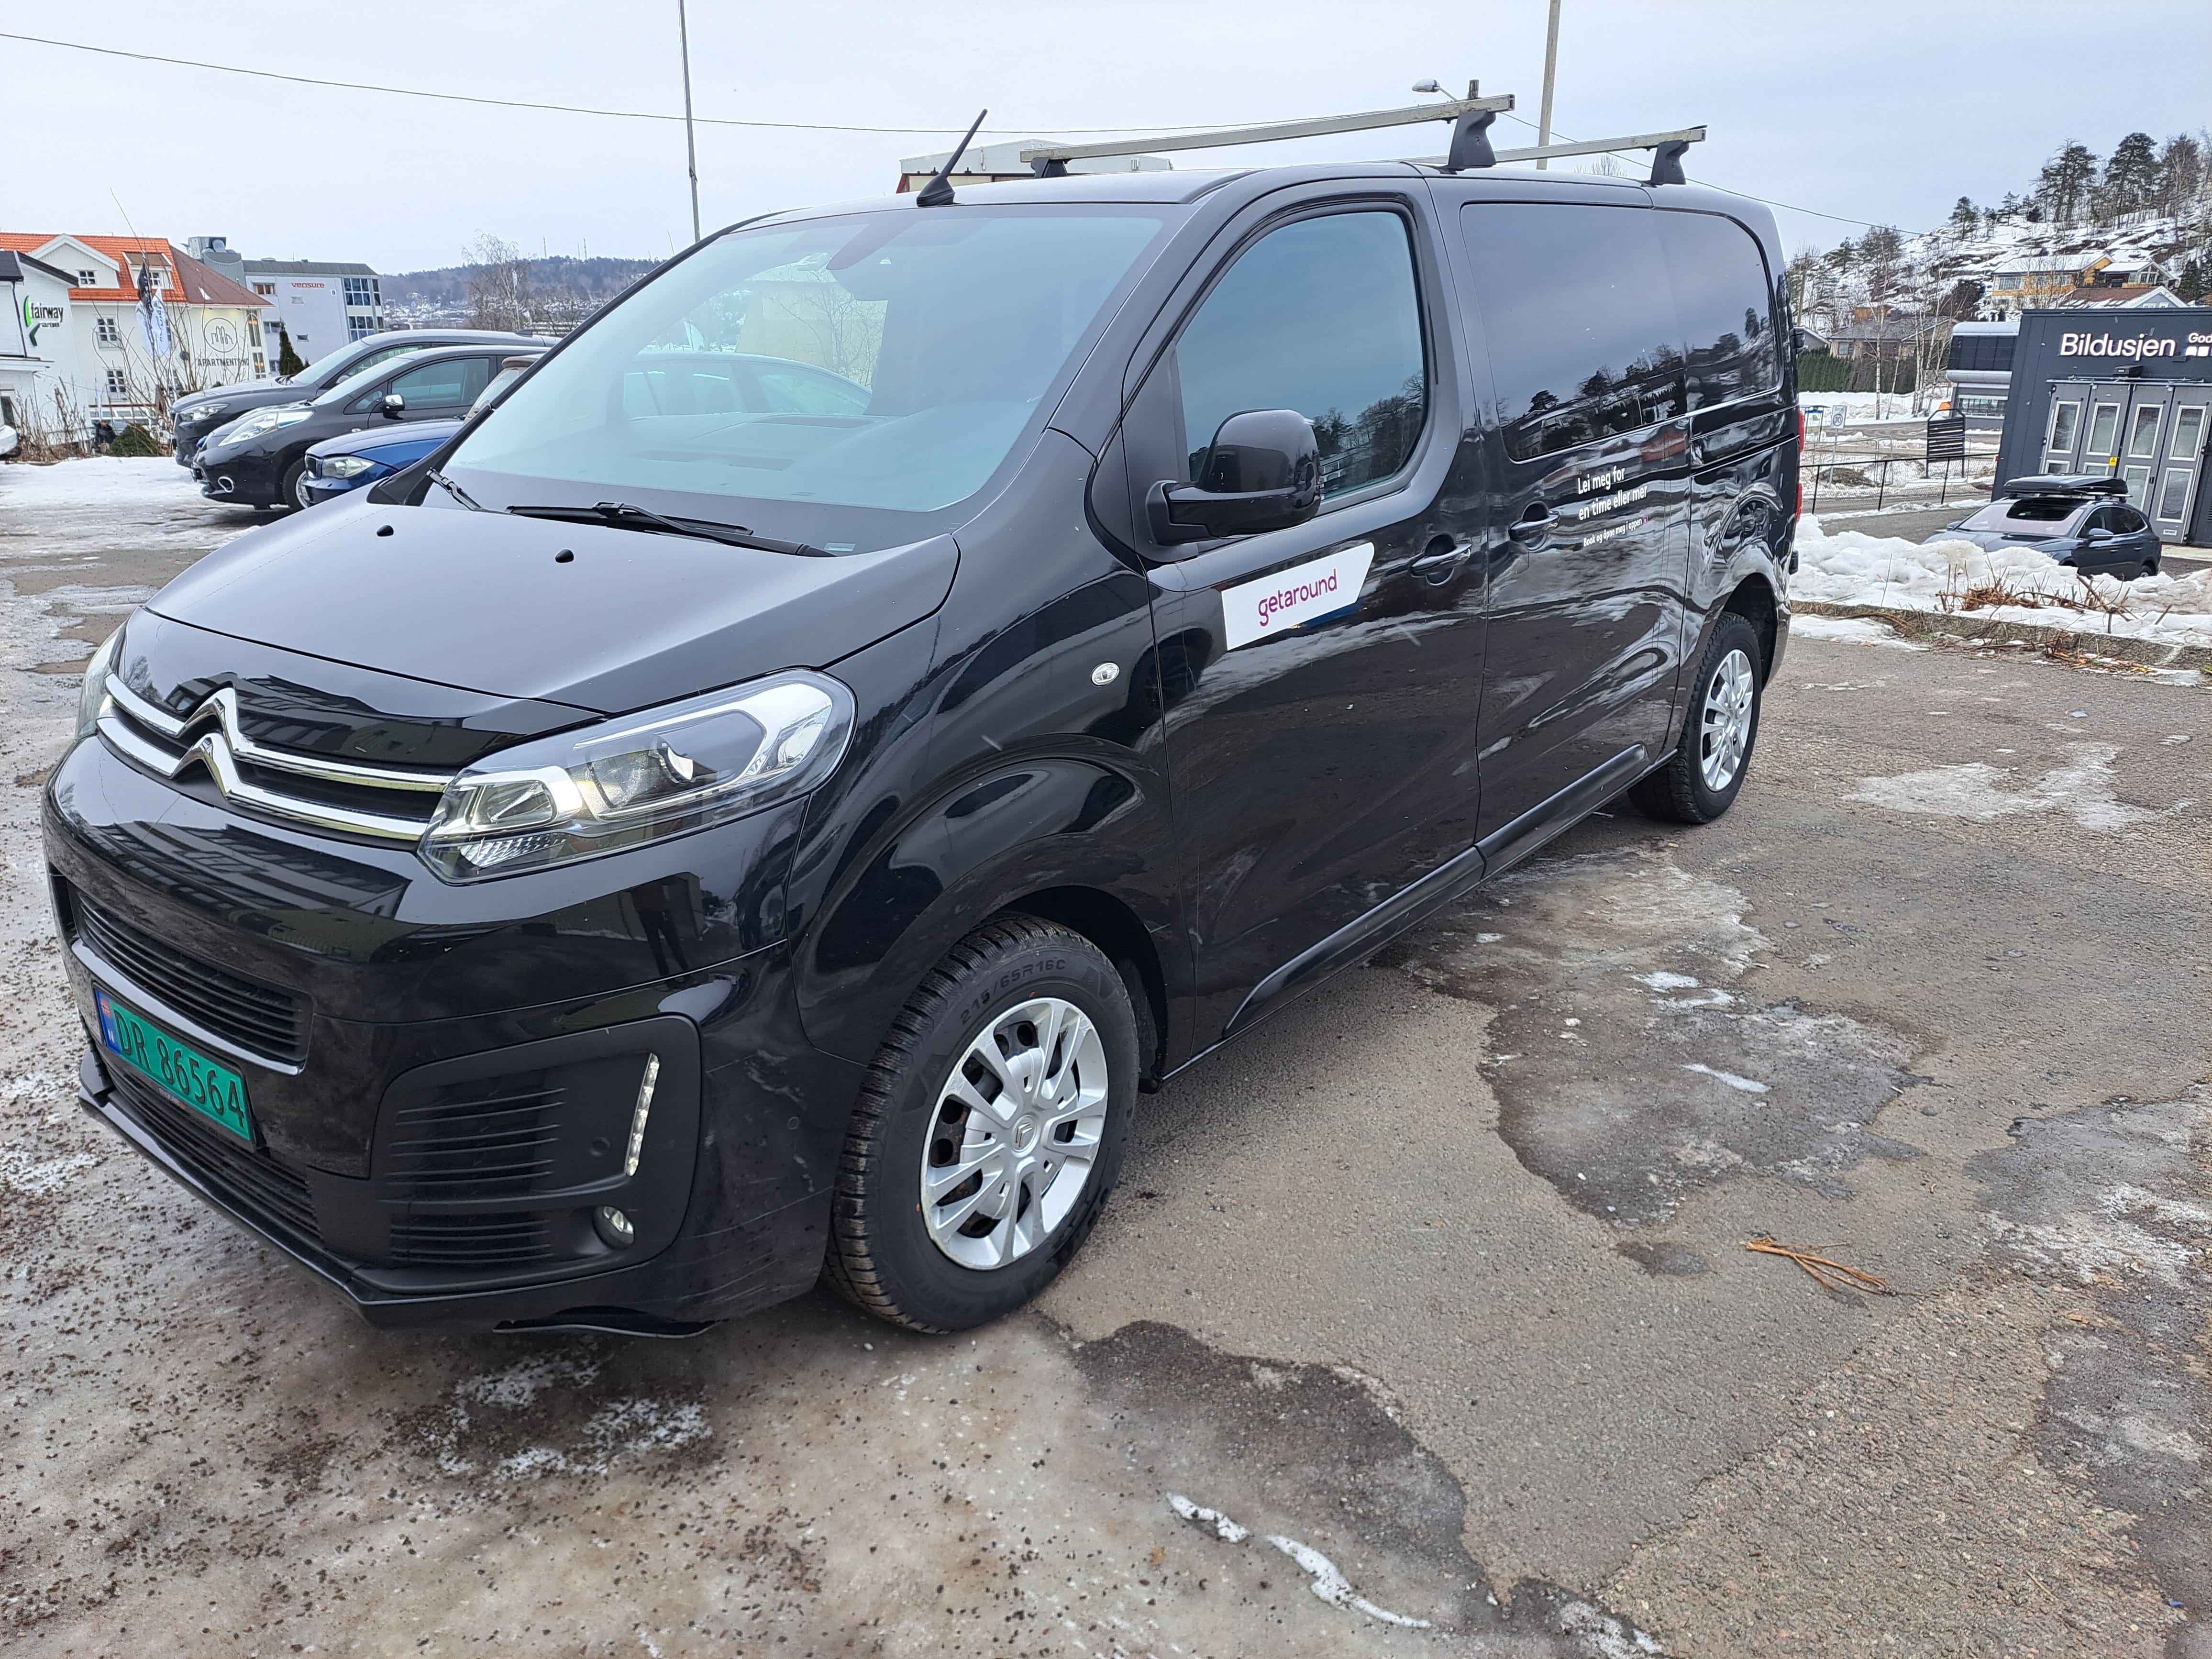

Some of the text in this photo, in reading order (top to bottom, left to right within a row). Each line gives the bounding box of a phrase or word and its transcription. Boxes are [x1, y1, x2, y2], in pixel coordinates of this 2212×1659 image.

[31, 302, 63, 322] fairway
[2060, 333, 2176, 361] Bildusjen
[1578, 465, 1625, 494] Lei meg for
[1579, 486, 1648, 520] en time eller mer
[1583, 534, 1596, 547] Book
[1596, 533, 1603, 543] og
[1603, 529, 1615, 541] åpne
[1615, 524, 1625, 534] meg
[1628, 518, 1642, 531] appen
[1258, 568, 1338, 627] getaround
[107, 1029, 115, 1044] N
[114, 1010, 244, 1128] DR 86564
